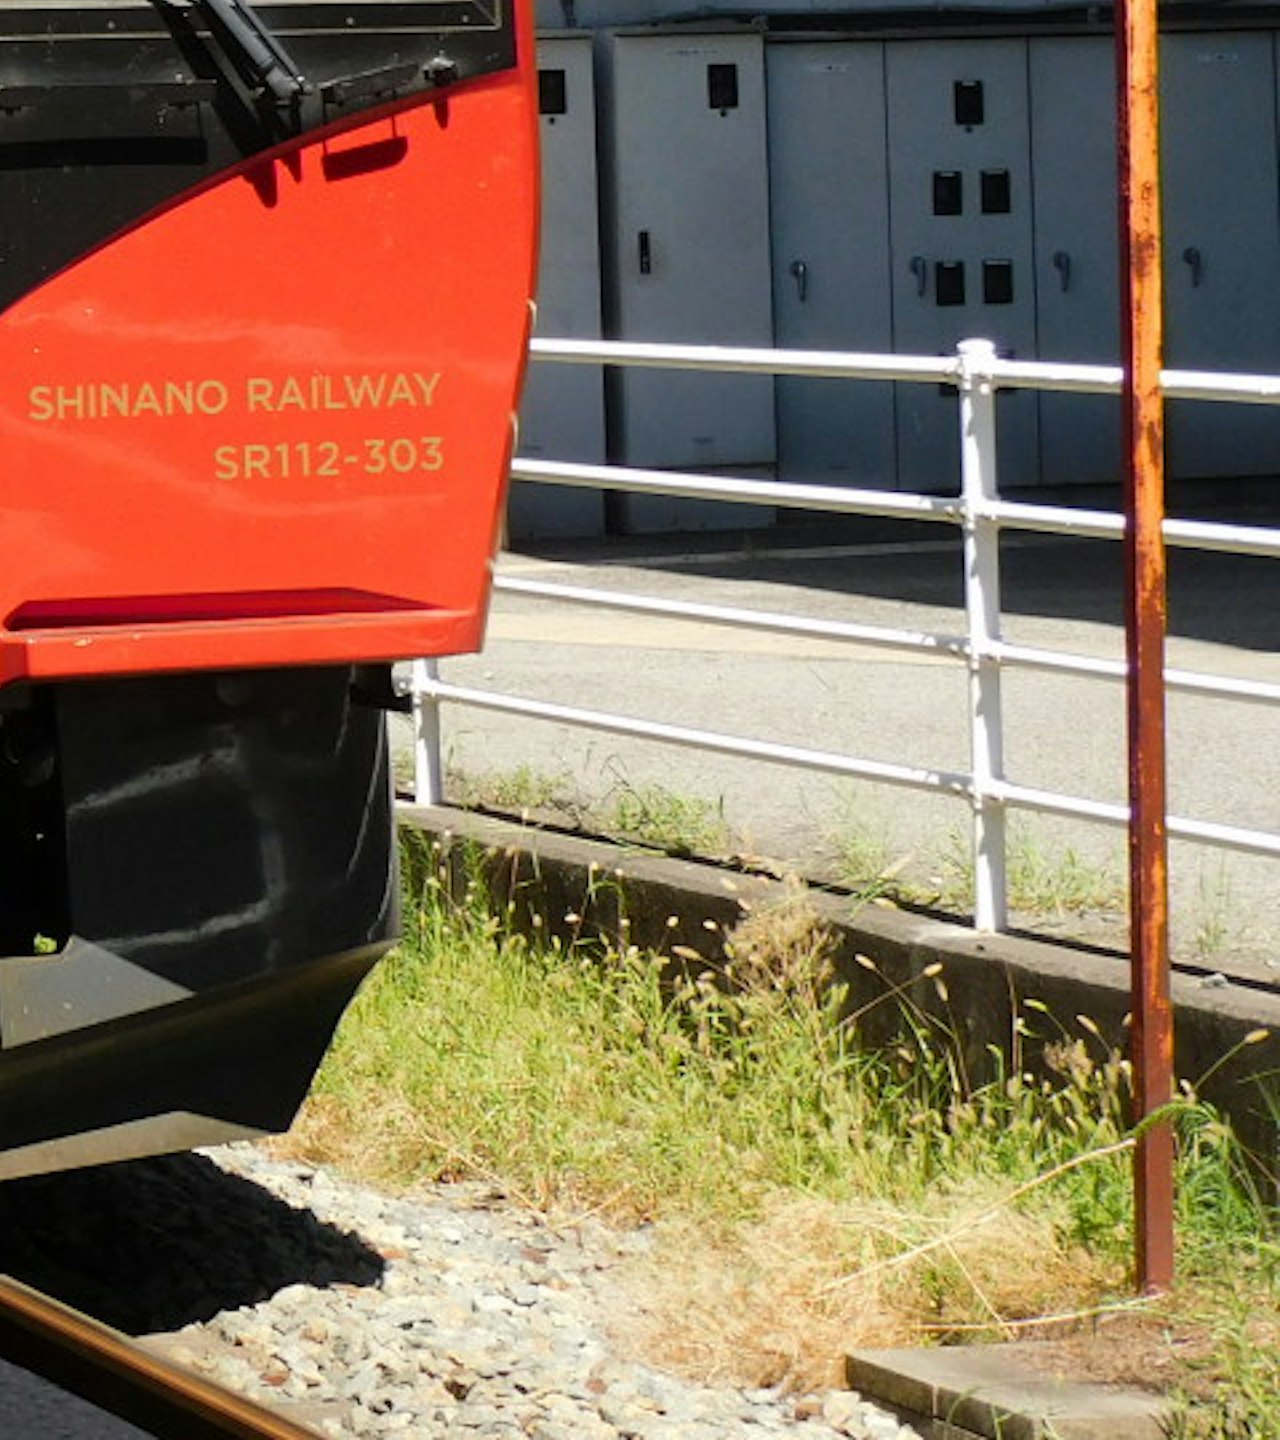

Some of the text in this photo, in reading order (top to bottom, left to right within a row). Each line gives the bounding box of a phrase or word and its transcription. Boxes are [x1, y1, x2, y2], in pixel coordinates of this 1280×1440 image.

[28, 372, 442, 422] SHINANO RAILWAY
[214, 436, 445, 481] SR112-303
